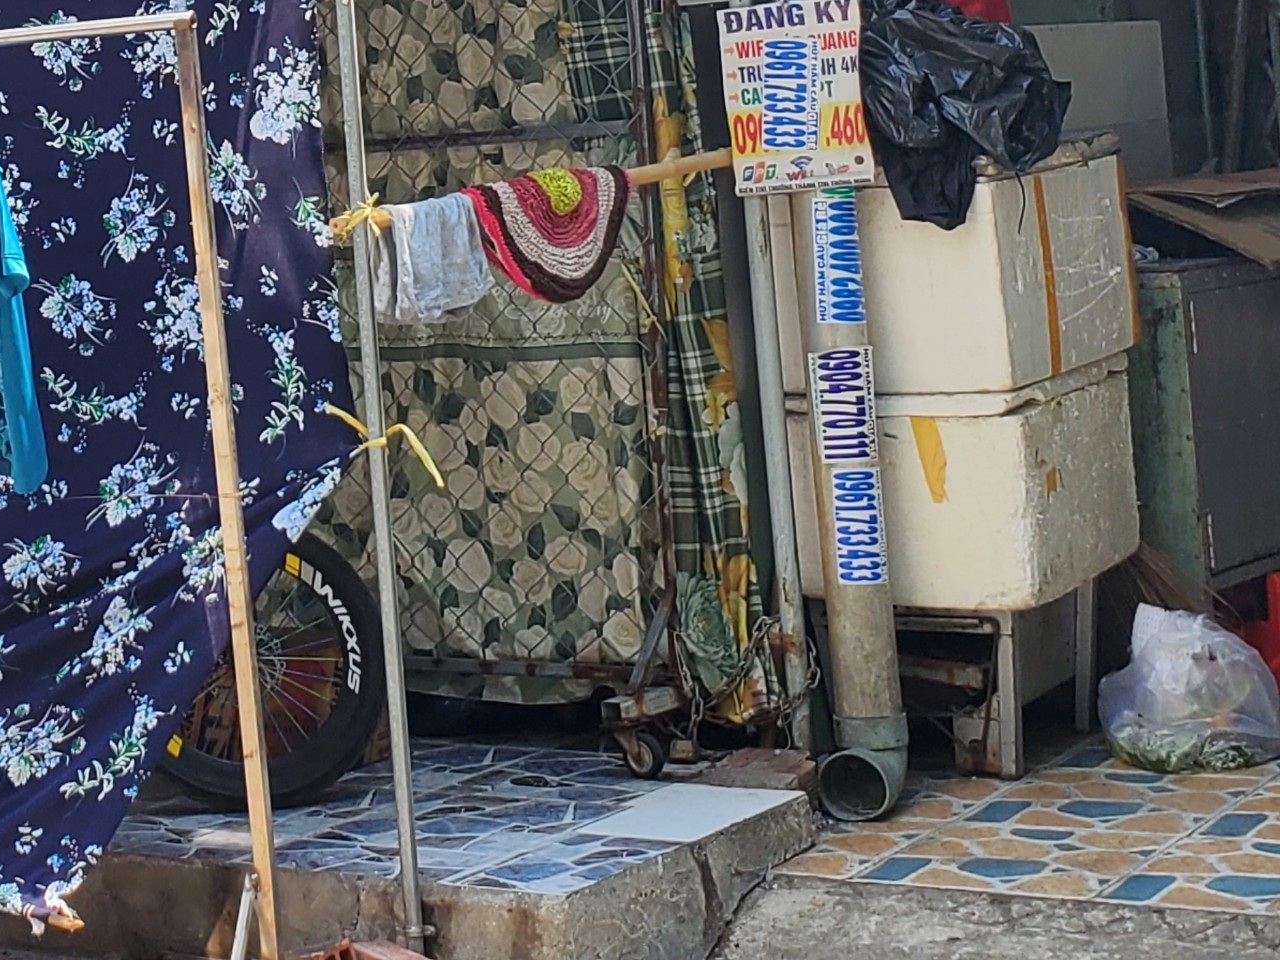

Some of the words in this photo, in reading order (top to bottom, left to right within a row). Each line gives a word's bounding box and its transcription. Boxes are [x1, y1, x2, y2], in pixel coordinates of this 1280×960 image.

[763, 40, 808, 149] 0961.733.433
[817, 350, 870, 460] 0904.770.111
[833, 471, 882, 582] 0961.733.433
